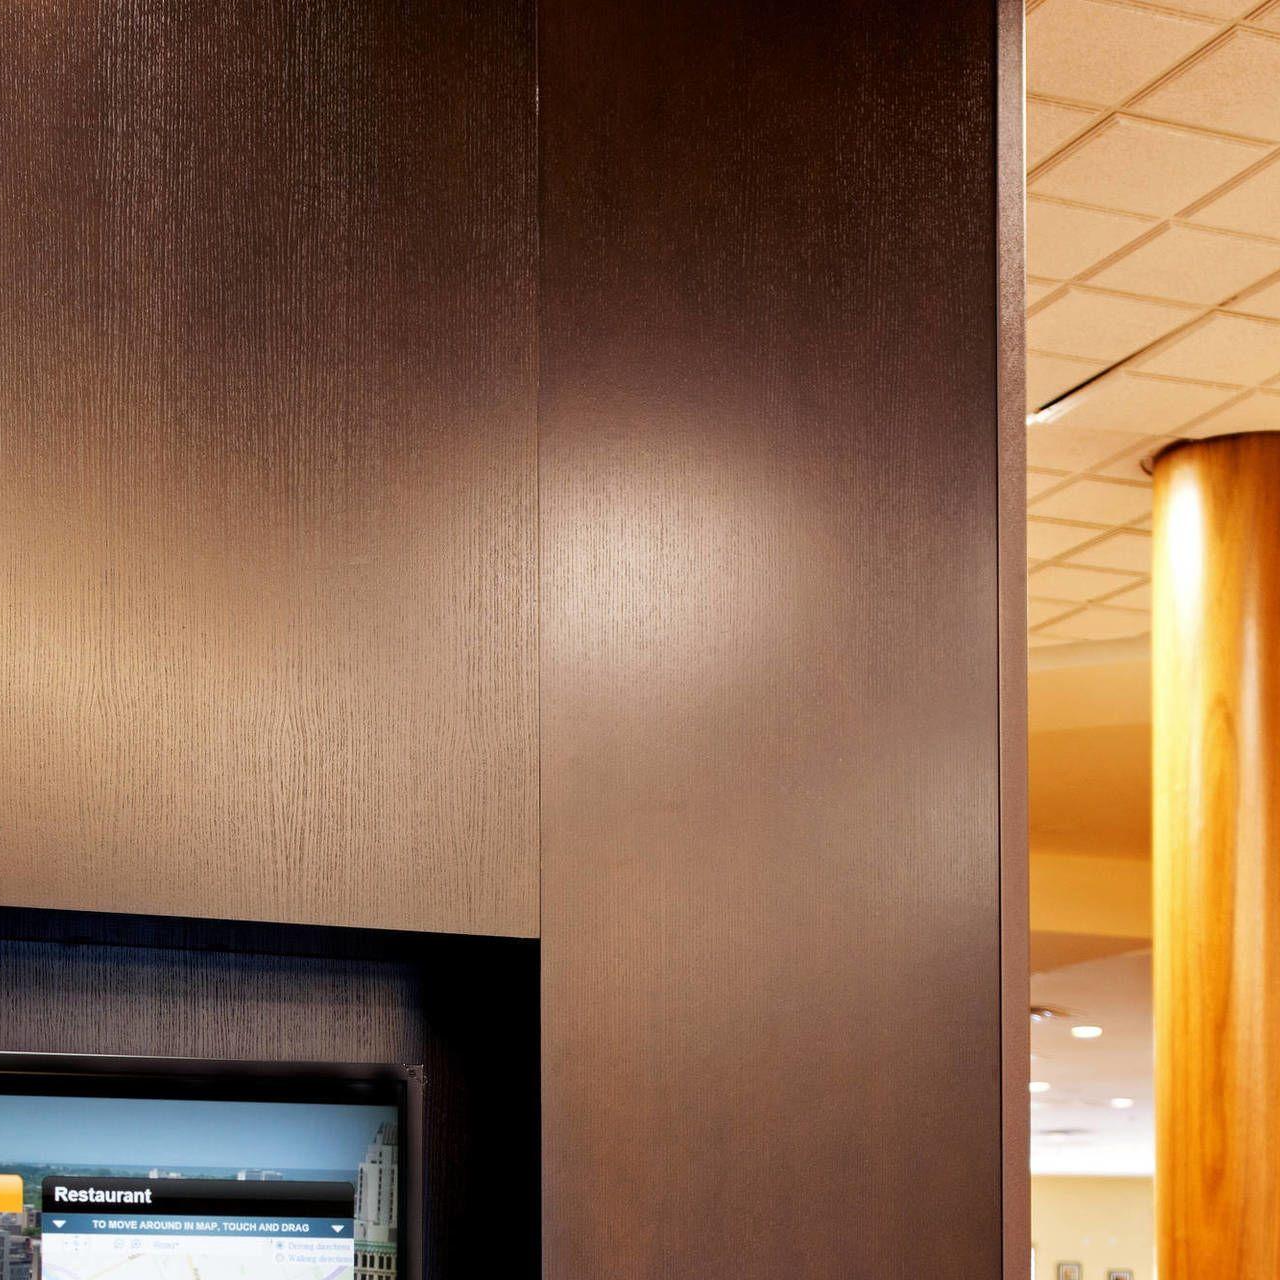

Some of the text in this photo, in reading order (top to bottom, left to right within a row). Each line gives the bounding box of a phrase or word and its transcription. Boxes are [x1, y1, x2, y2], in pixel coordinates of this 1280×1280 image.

[54, 1186, 152, 1204] Restaurant
[92, 1220, 106, 1229] TO
[108, 1220, 138, 1229] MOVE
[140, 1221, 182, 1230] AROUND
[184, 1222, 194, 1230] IN
[222, 1222, 256, 1232] TOUCH
[258, 1223, 279, 1232] AND
[281, 1223, 310, 1232] DRAG
